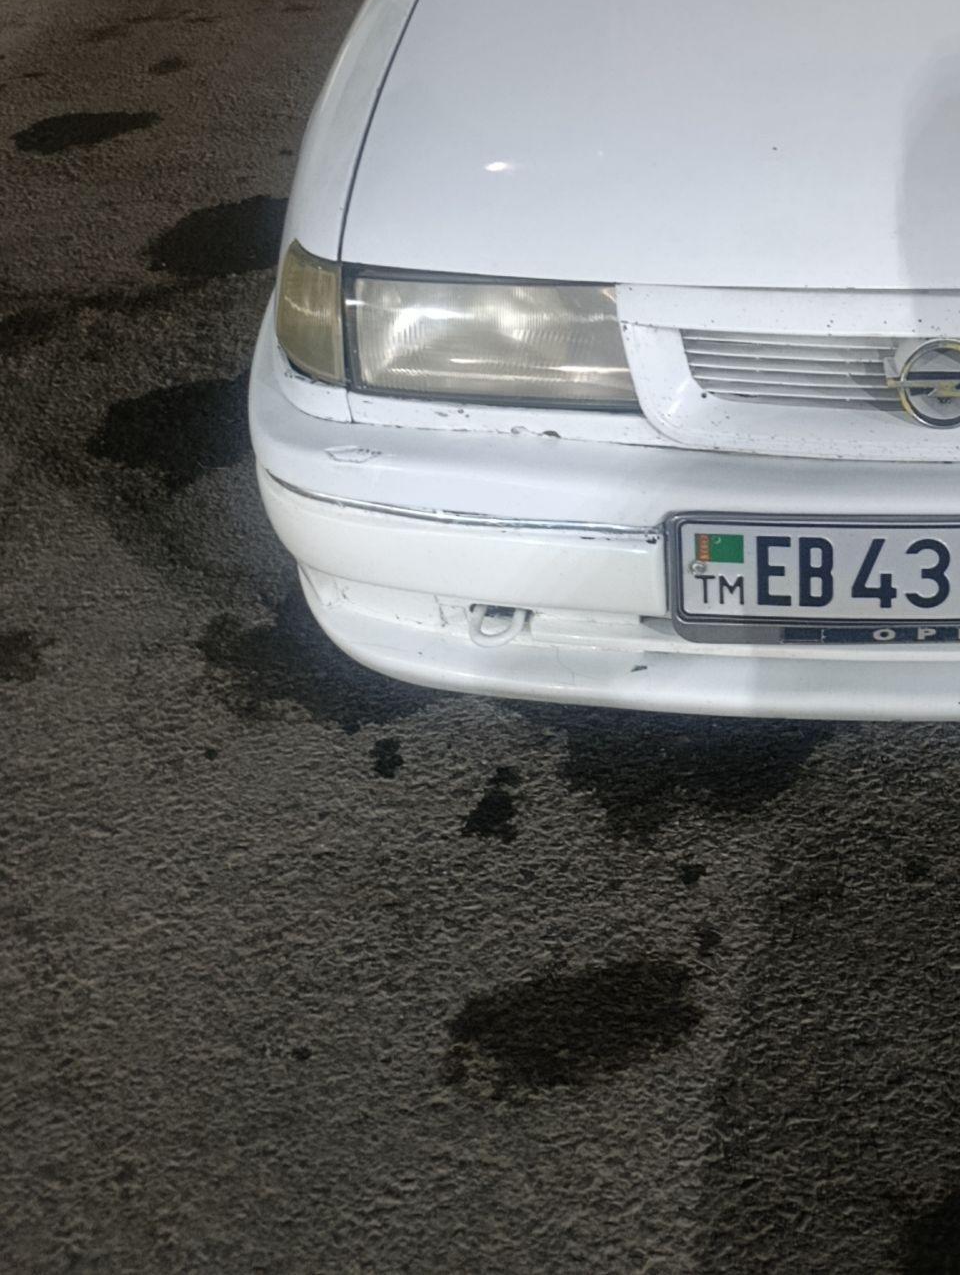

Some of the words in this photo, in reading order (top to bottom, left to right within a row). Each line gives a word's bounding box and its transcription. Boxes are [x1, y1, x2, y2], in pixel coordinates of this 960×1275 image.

[694, 574, 745, 605] TM
[756, 535, 835, 607] EB
[851, 537, 951, 610] 43
